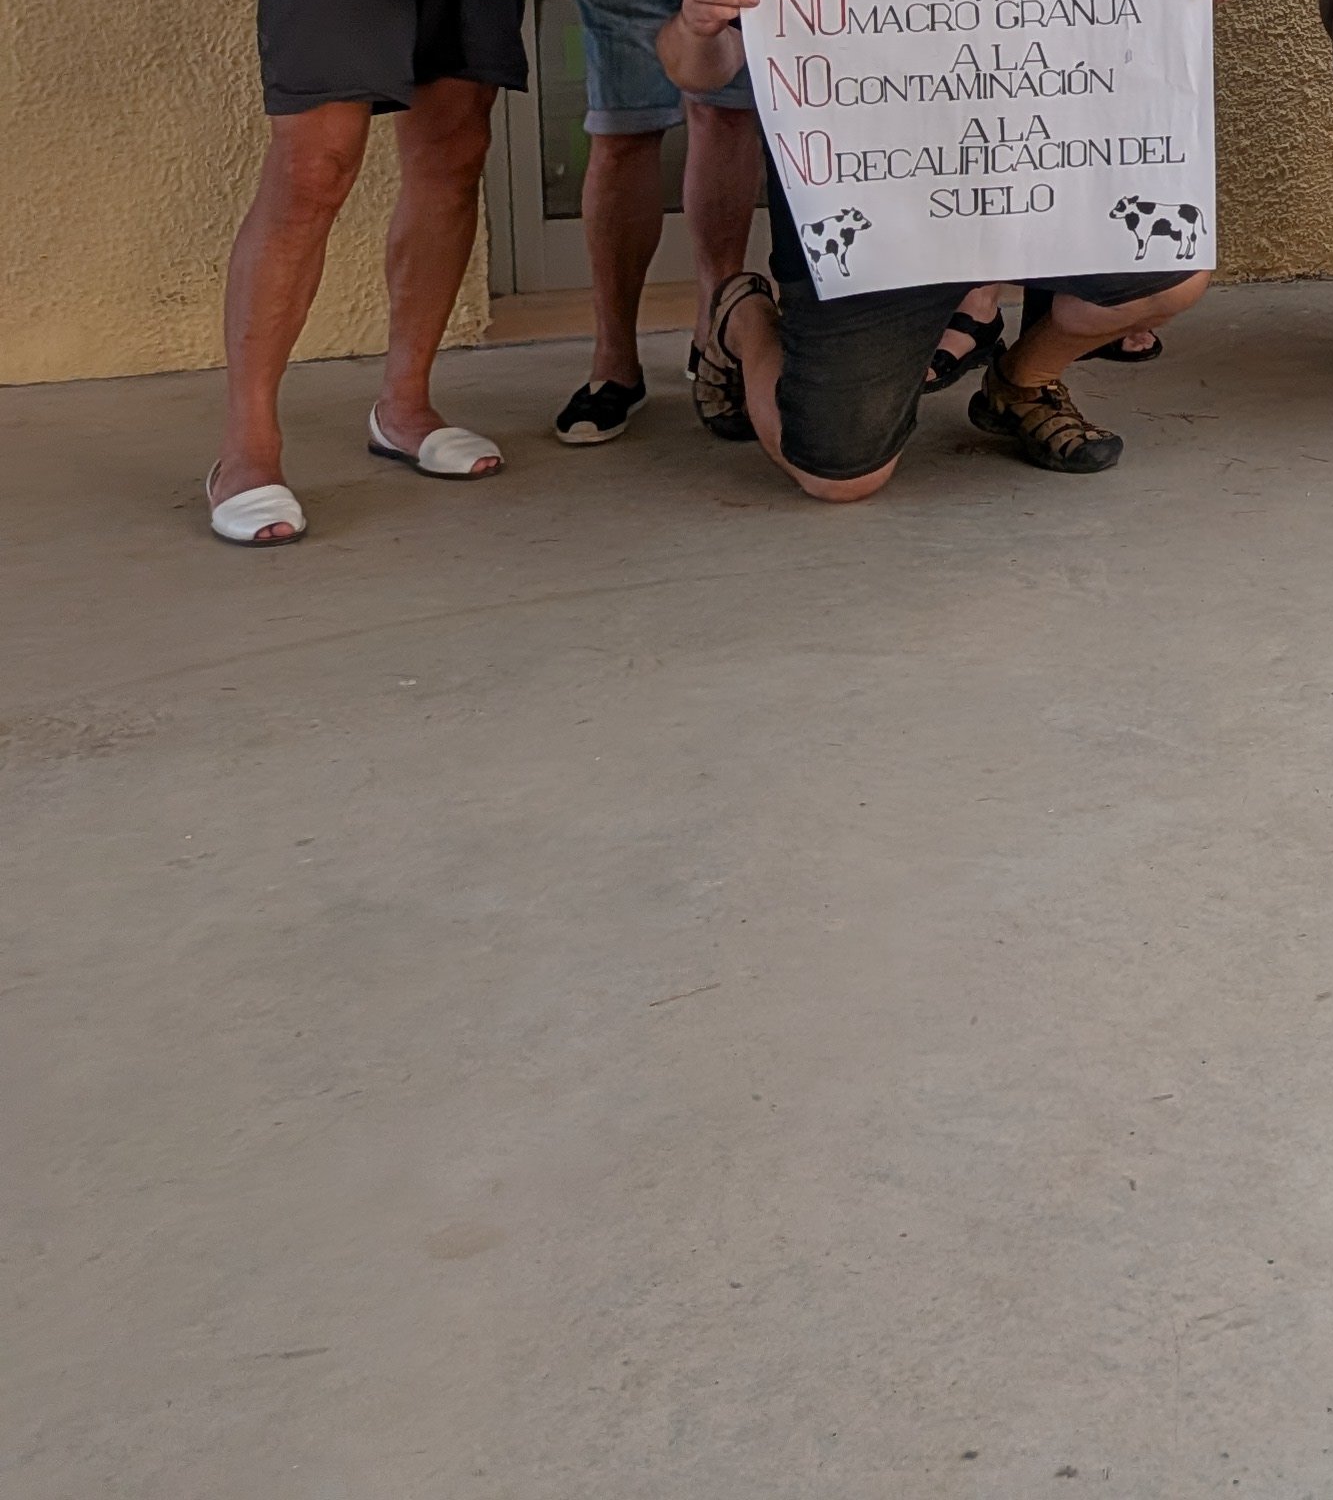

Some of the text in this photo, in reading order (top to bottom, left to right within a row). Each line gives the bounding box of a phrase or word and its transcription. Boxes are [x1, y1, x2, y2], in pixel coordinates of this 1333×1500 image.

[847, 1, 980, 34] MACRO
[950, 42, 1051, 73] A LA
[768, 55, 1114, 111] NO CONTAMINACIÓN
[958, 115, 1051, 145] A LA
[775, 130, 1186, 189] NO RECALIFICACION DEL
[930, 184, 1054, 219] SUELO
